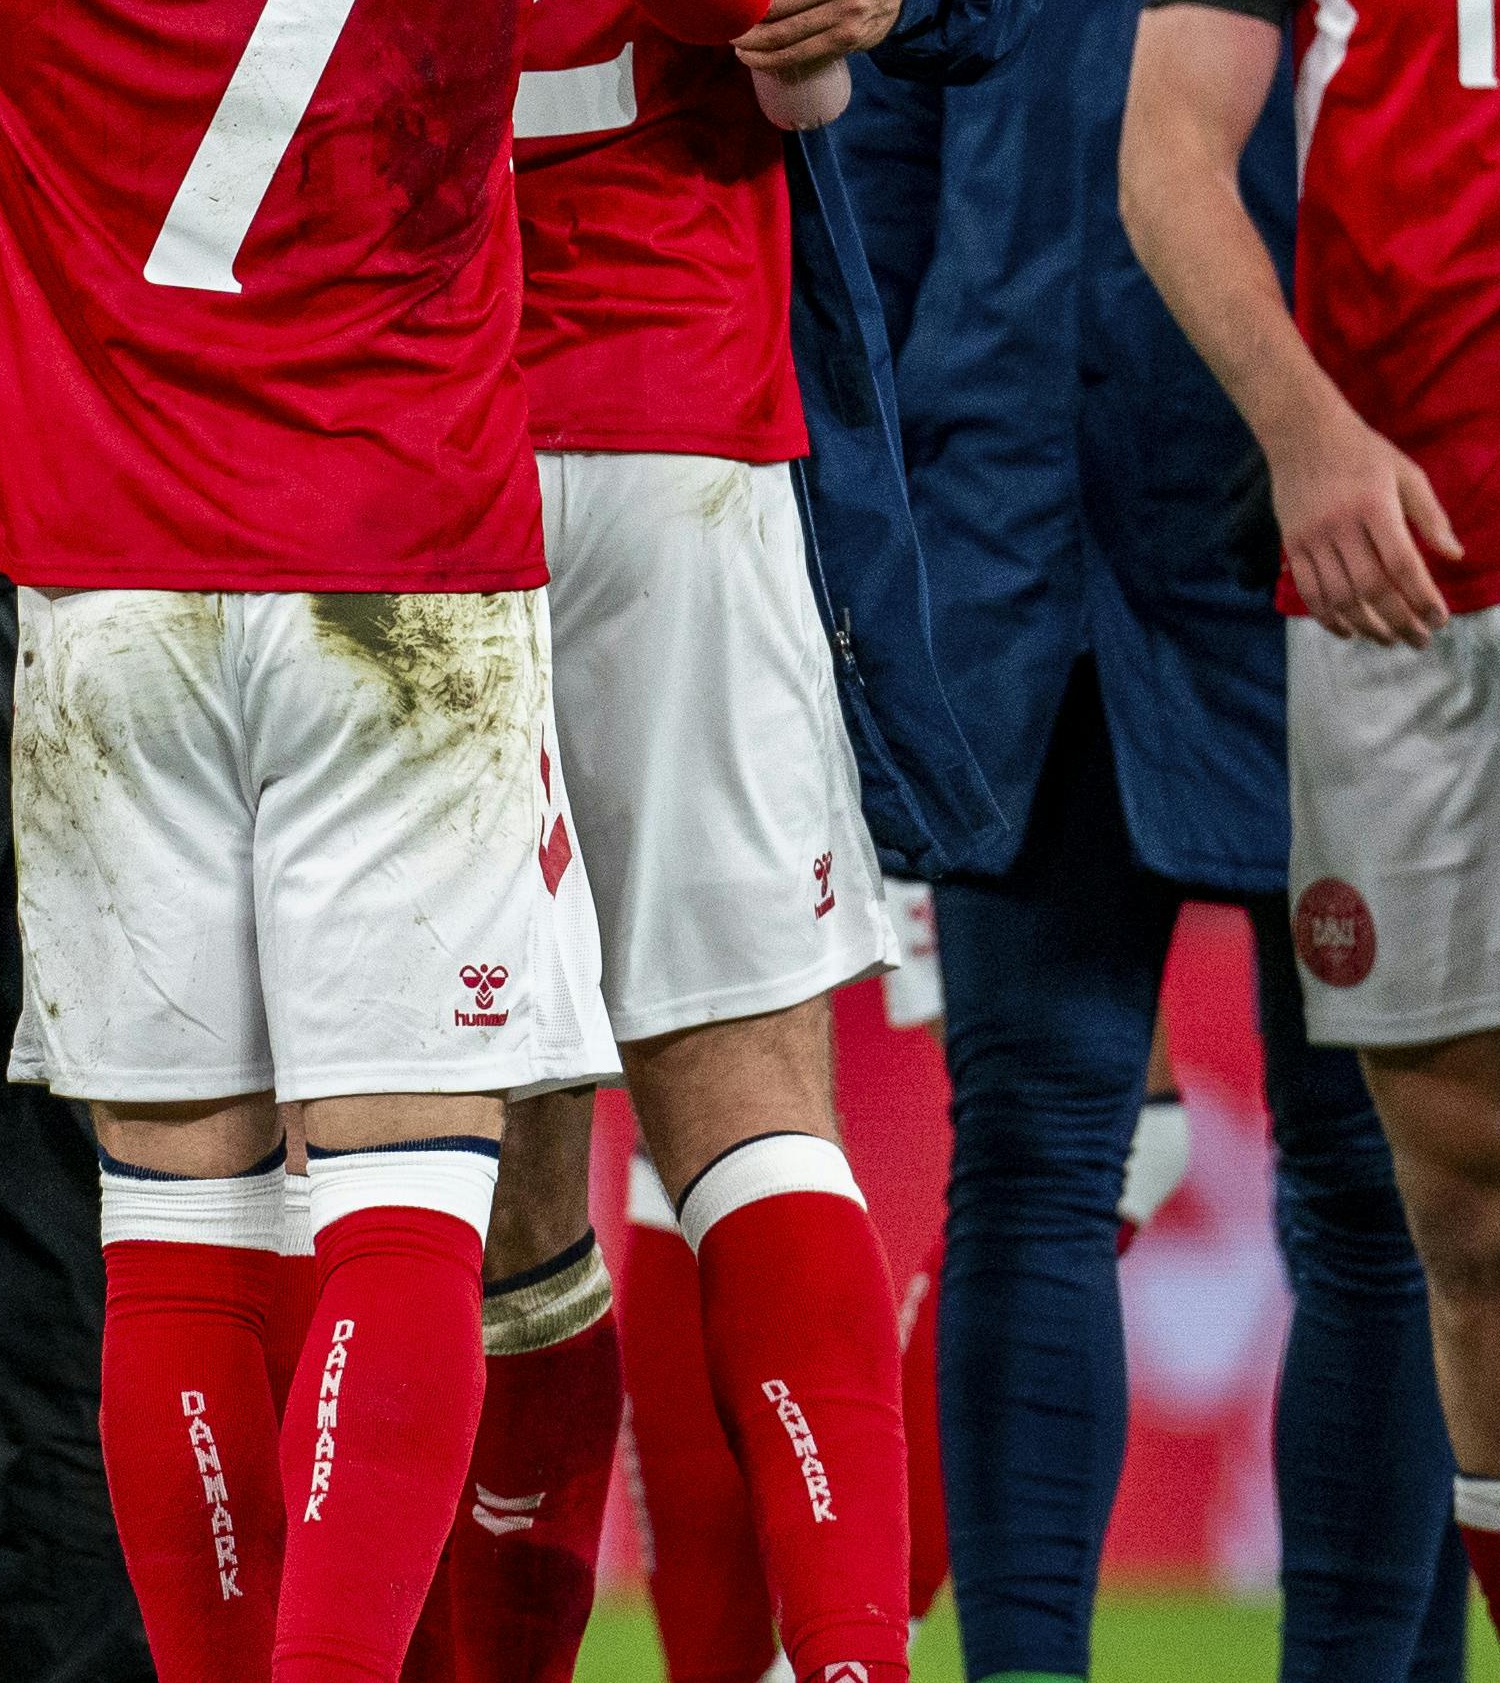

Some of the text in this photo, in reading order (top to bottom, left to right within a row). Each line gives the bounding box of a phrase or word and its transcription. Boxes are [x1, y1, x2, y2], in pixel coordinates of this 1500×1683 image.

[454, 1009, 509, 1026] hummel
[180, 1390, 243, 1600] DANMARK
[304, 1319, 355, 1523] DANMARK
[761, 1379, 837, 1523] DANMARK
